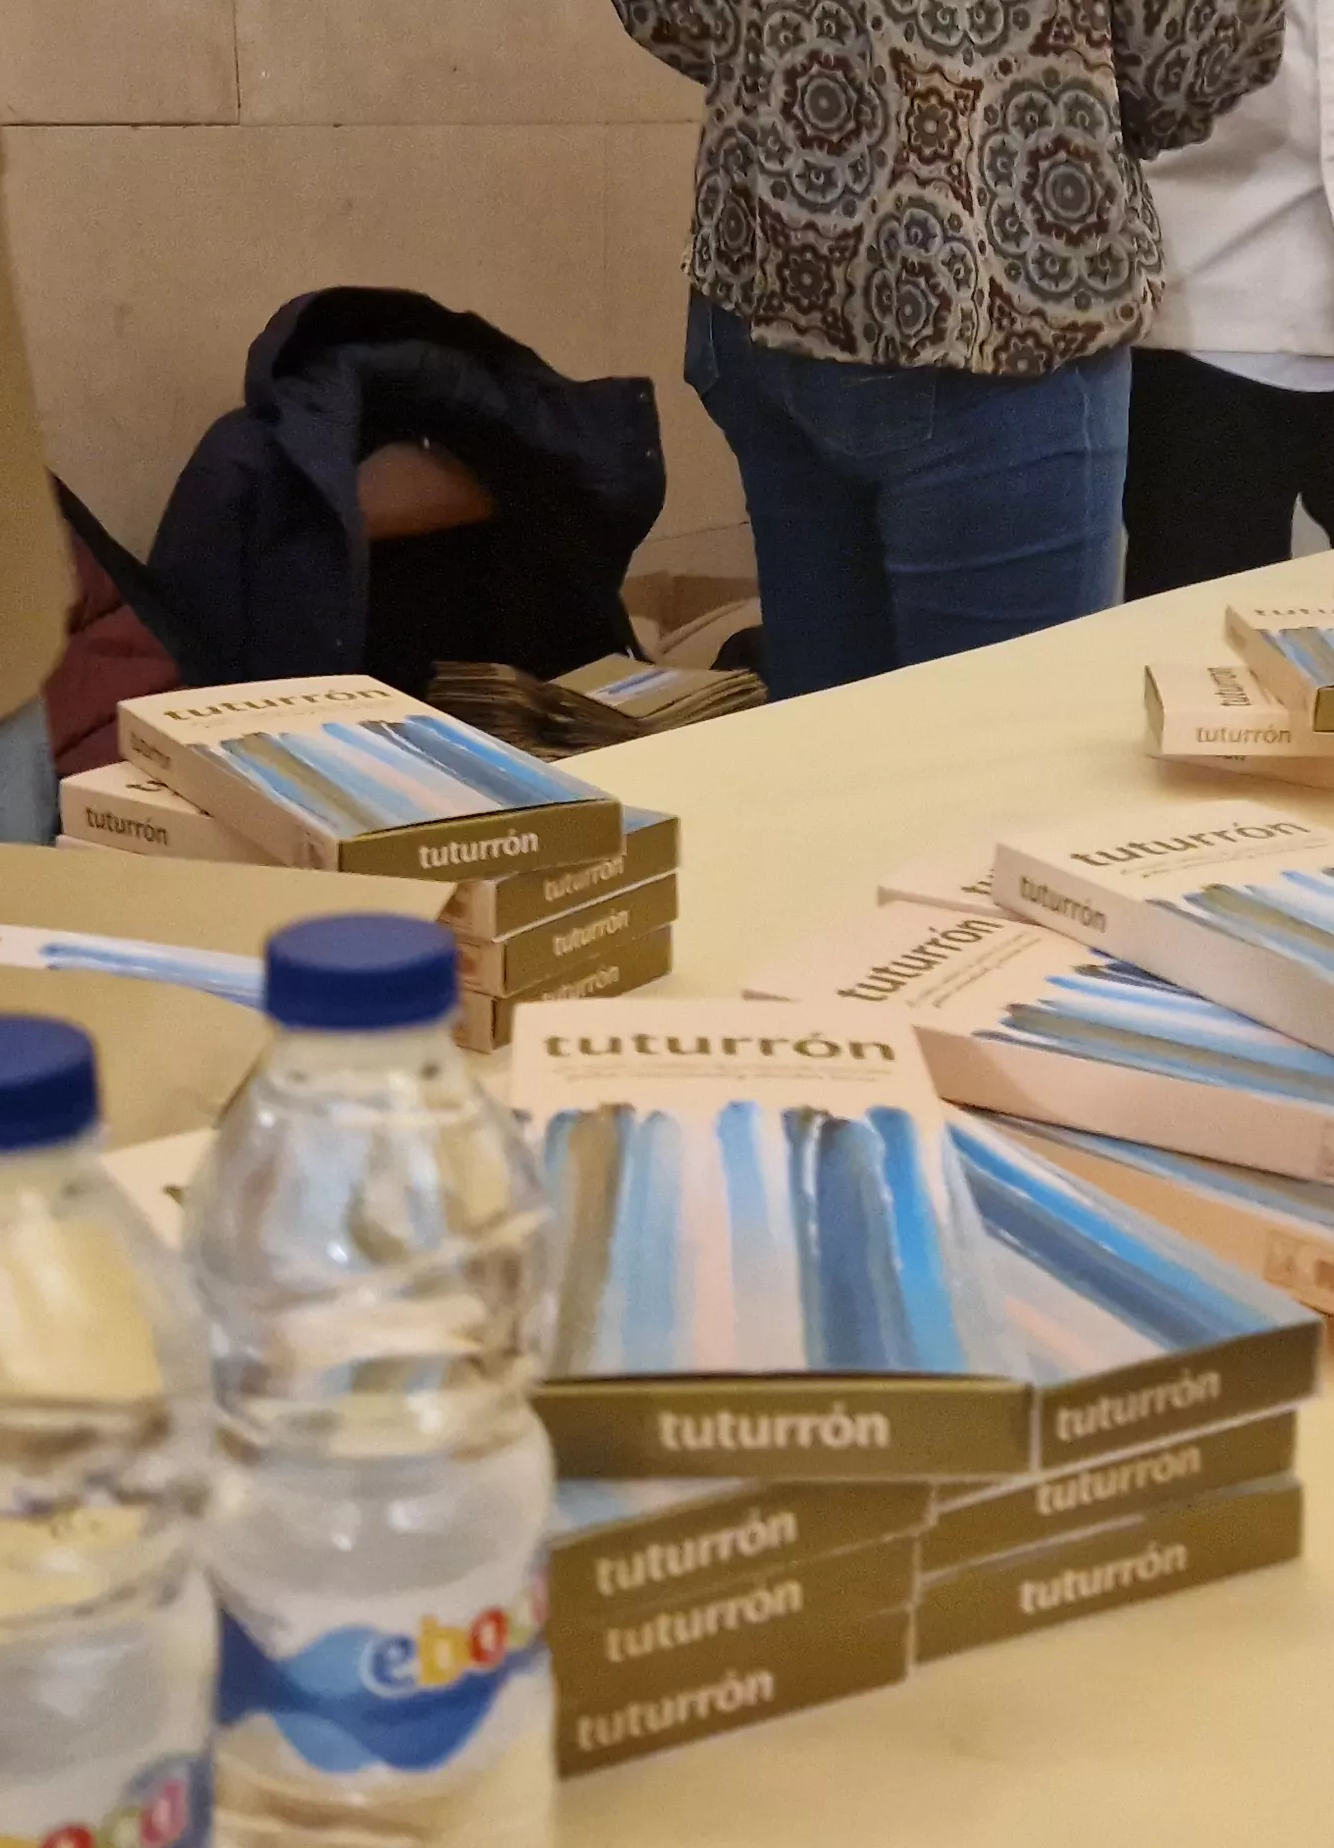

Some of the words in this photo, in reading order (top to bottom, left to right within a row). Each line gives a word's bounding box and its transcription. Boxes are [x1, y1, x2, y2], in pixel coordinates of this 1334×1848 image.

[164, 688, 392, 721] tuturrón
[1195, 724, 1292, 745] tuturrón
[84, 806, 168, 847] tuturrón
[418, 828, 539, 869] tuturrón
[1070, 820, 1312, 868] tuturrón
[1019, 873, 1107, 934] tuturrón
[837, 916, 1004, 1003] tuturrón
[543, 1031, 896, 1061] tuturrón
[658, 1403, 890, 1452] tuturrón
[1056, 1366, 1220, 1442] tuturrón
[1037, 1443, 1202, 1517] tuturrón
[594, 1507, 801, 1597] tuturrón
[1019, 1541, 1188, 1615] tuturrón
[605, 1578, 805, 1664] tuturrón
[575, 1668, 776, 1753] tuturrón
